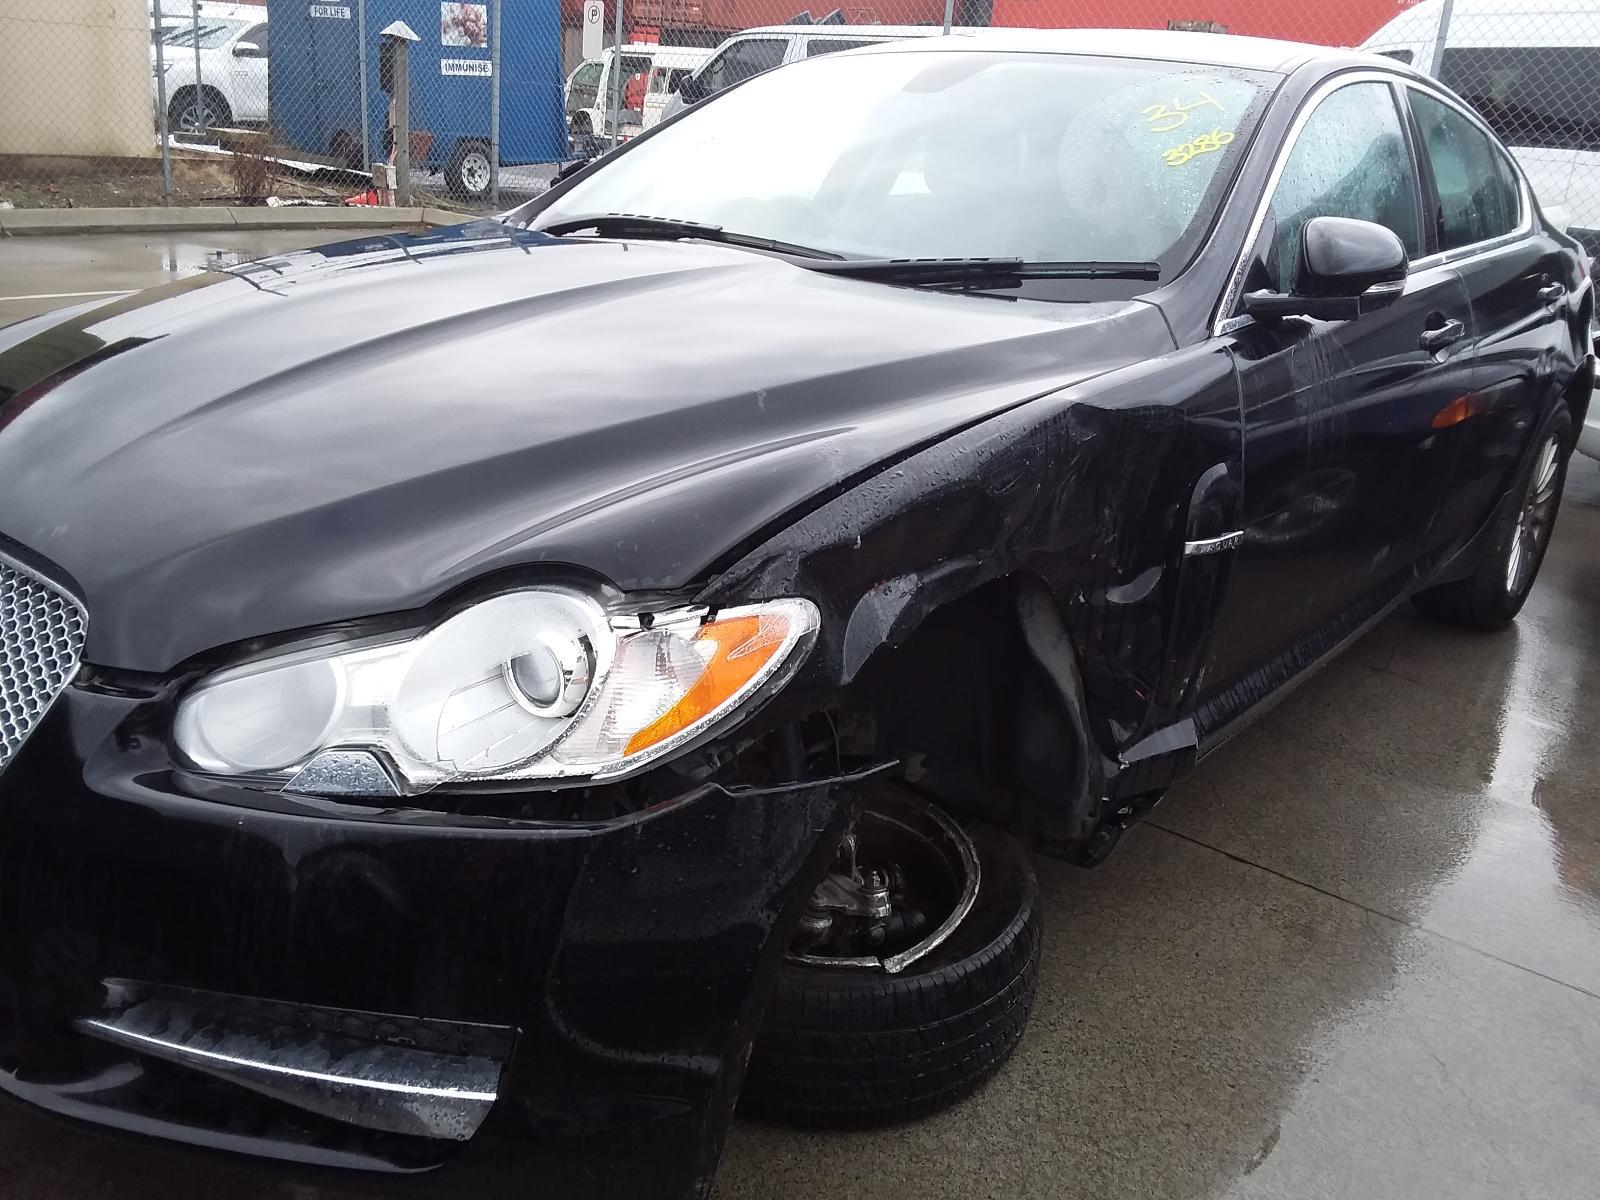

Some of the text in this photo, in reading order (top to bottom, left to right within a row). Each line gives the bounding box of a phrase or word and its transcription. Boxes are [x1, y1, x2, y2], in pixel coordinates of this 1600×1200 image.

[314, 6, 346, 17] FOR LIFE
[444, 62, 489, 73] IMMUNISE
